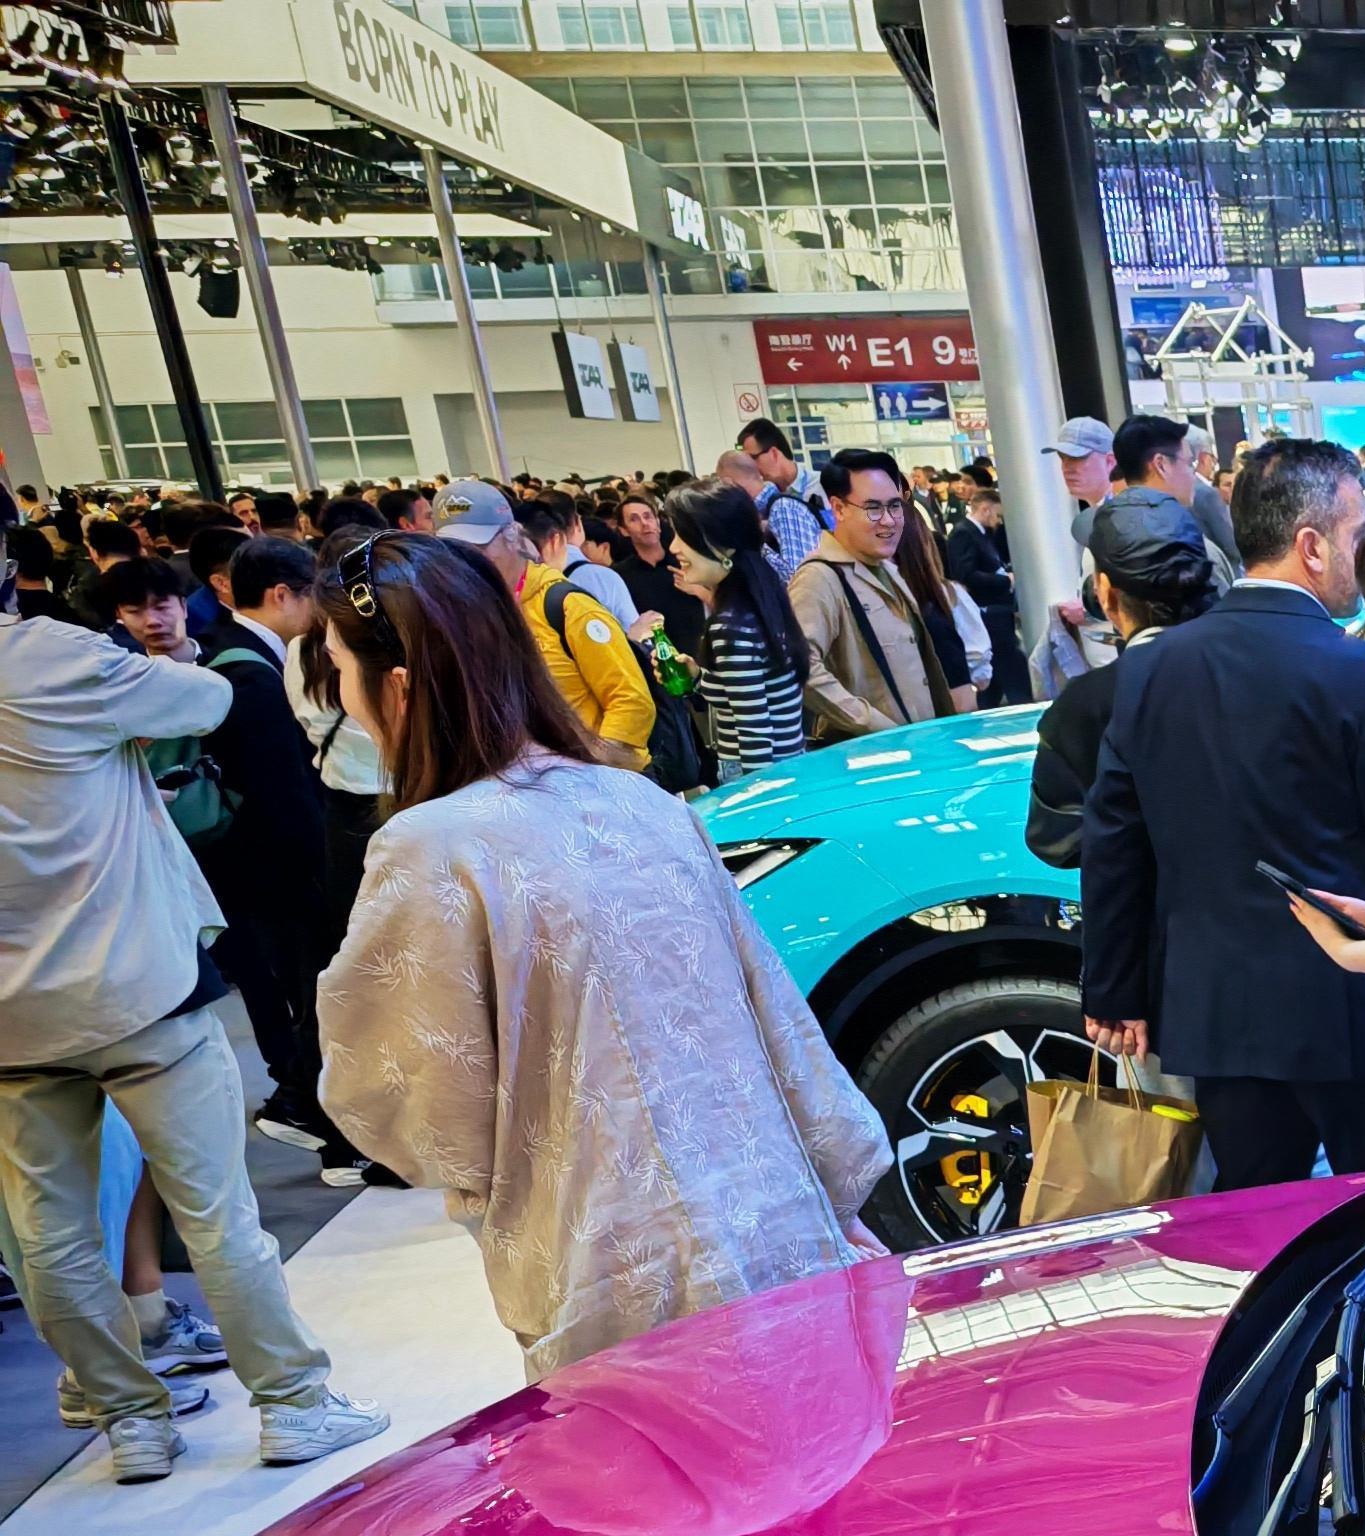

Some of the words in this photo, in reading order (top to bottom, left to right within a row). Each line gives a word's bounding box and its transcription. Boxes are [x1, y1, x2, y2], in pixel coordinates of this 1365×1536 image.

[333, 0, 419, 112] BORN
[413, 41, 453, 128] TO
[450, 62, 504, 152] PLAY
[825, 334, 857, 352] W1
[867, 337, 914, 367] E1
[932, 336, 956, 365] 9
